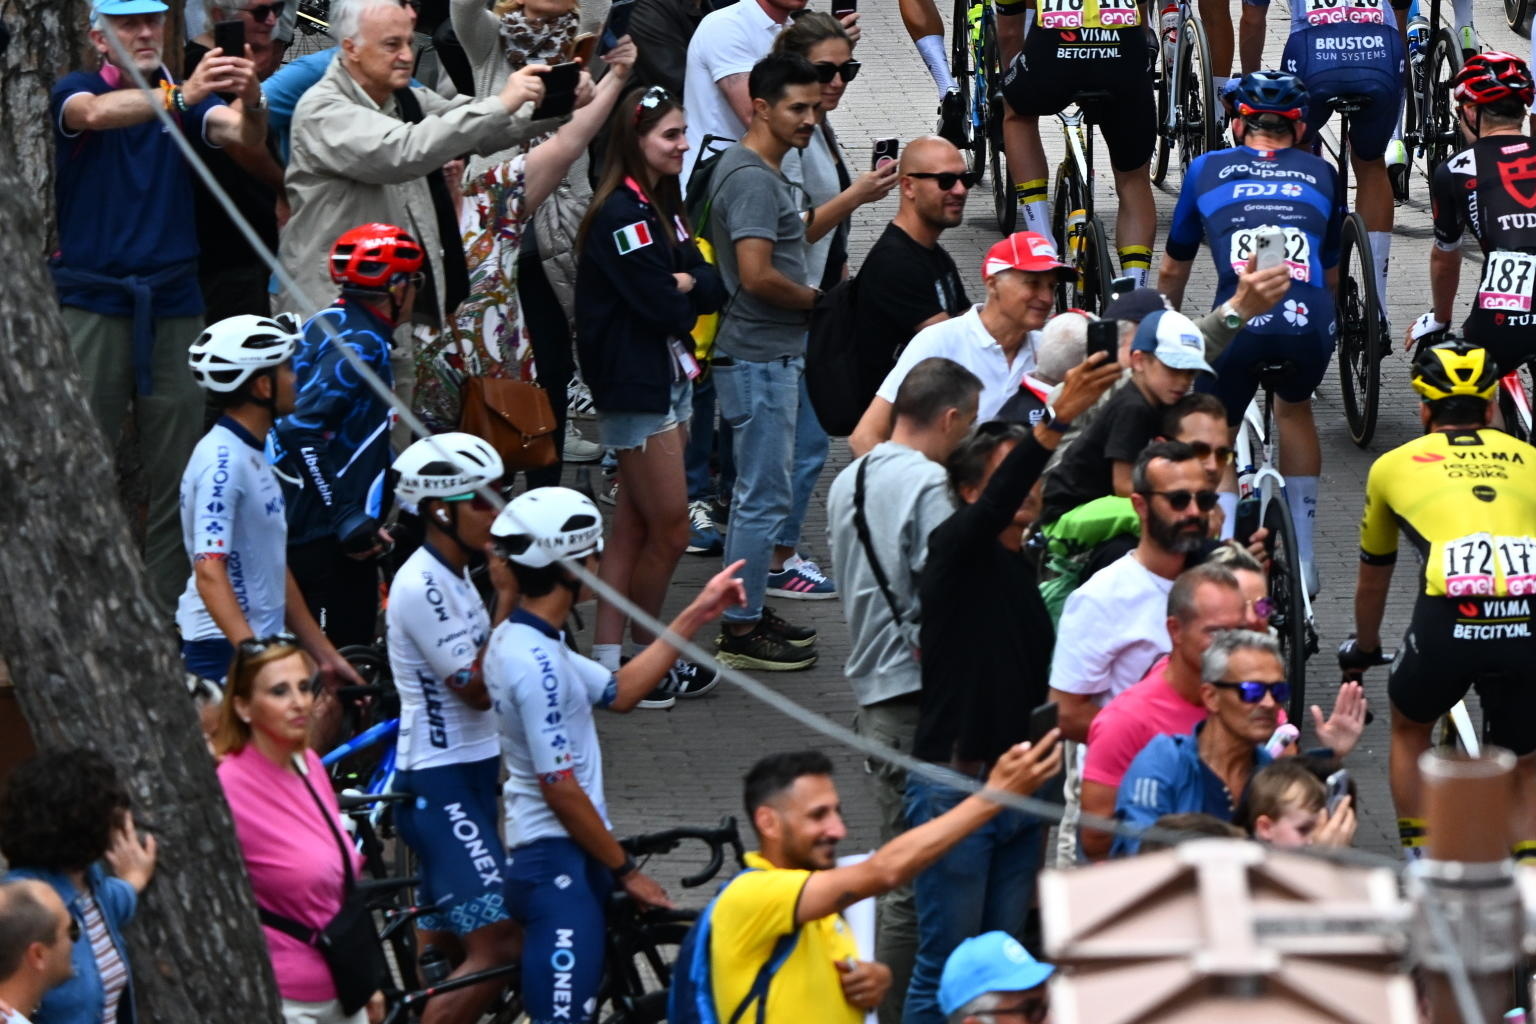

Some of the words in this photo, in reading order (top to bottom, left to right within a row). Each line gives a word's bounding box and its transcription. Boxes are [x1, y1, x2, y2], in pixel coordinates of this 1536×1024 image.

[1043, 13, 1082, 27] enel
[1309, 9, 1348, 24] enel
[1350, 10, 1383, 24] enel
[1081, 29, 1120, 41] VISMA
[1315, 35, 1384, 50] BRUSTOR
[1057, 47, 1121, 59] BETCITY.NL
[1315, 52, 1338, 60] SUN
[1341, 50, 1386, 61] SYSTEMS
[1218, 162, 1318, 183] Groupama
[1232, 183, 1277, 197] FDJ
[1243, 203, 1294, 211] Groupama
[1485, 257, 1530, 292] 187
[1485, 295, 1527, 309] enel
[1452, 452, 1524, 464] VISMA
[1447, 543, 1492, 575] 172
[1451, 577, 1492, 594] enel
[1484, 600, 1530, 617] VISMA
[1454, 625, 1531, 638] BETCITY.NL
[417, 670, 447, 748] GIANT
[444, 802, 502, 886] MONEX
[552, 929, 575, 1018] MONEX
